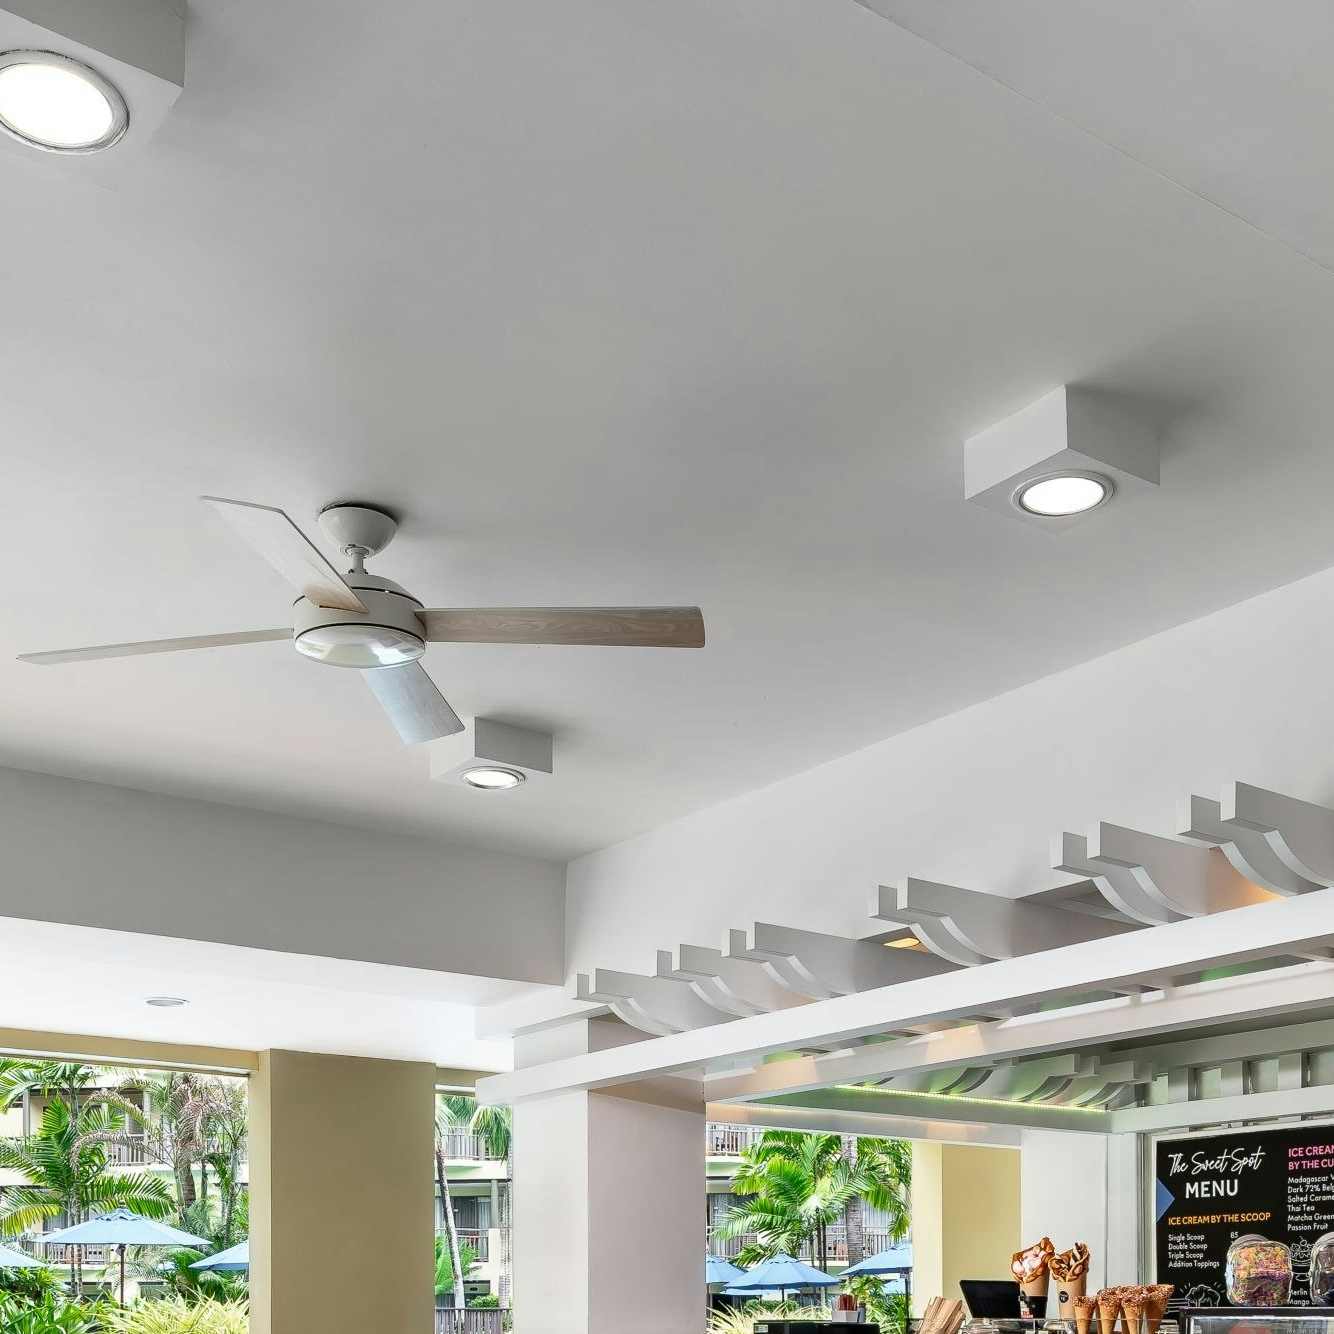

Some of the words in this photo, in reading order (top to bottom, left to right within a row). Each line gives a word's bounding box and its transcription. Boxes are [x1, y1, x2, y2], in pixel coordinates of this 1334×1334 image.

[1288, 1148, 1304, 1158] ICE
[1168, 1153, 1188, 1176] The
[1191, 1149, 1231, 1175] Sweet
[1231, 1145, 1265, 1175] Spot
[1288, 1161, 1300, 1170] BY
[1301, 1160, 1320, 1169] THE
[1287, 1175, 1329, 1184] Madagascar
[1185, 1179, 1238, 1198] MENU
[1287, 1186, 1304, 1194] Dark
[1305, 1184, 1321, 1192] 72%
[1287, 1195, 1307, 1203] Salted
[1287, 1204, 1302, 1212] Thai
[1168, 1217, 1182, 1226] ICE
[1182, 1215, 1210, 1225] CREAM
[1212, 1214, 1222, 1223] BY
[1223, 1214, 1239, 1223] THE
[1240, 1212, 1271, 1222] SCOOP
[1287, 1214, 1312, 1222] Matcha
[1314, 1213, 1334, 1221] Green
[1287, 1223, 1312, 1231] Passion
[1313, 1222, 1329, 1230] Fruit
[1168, 1234, 1185, 1242] Single
[1186, 1233, 1205, 1241] Scoop
[1189, 1242, 1207, 1251] Scoop
[1185, 1251, 1204, 1260] Scoop
[1193, 1260, 1220, 1269] Toppings
